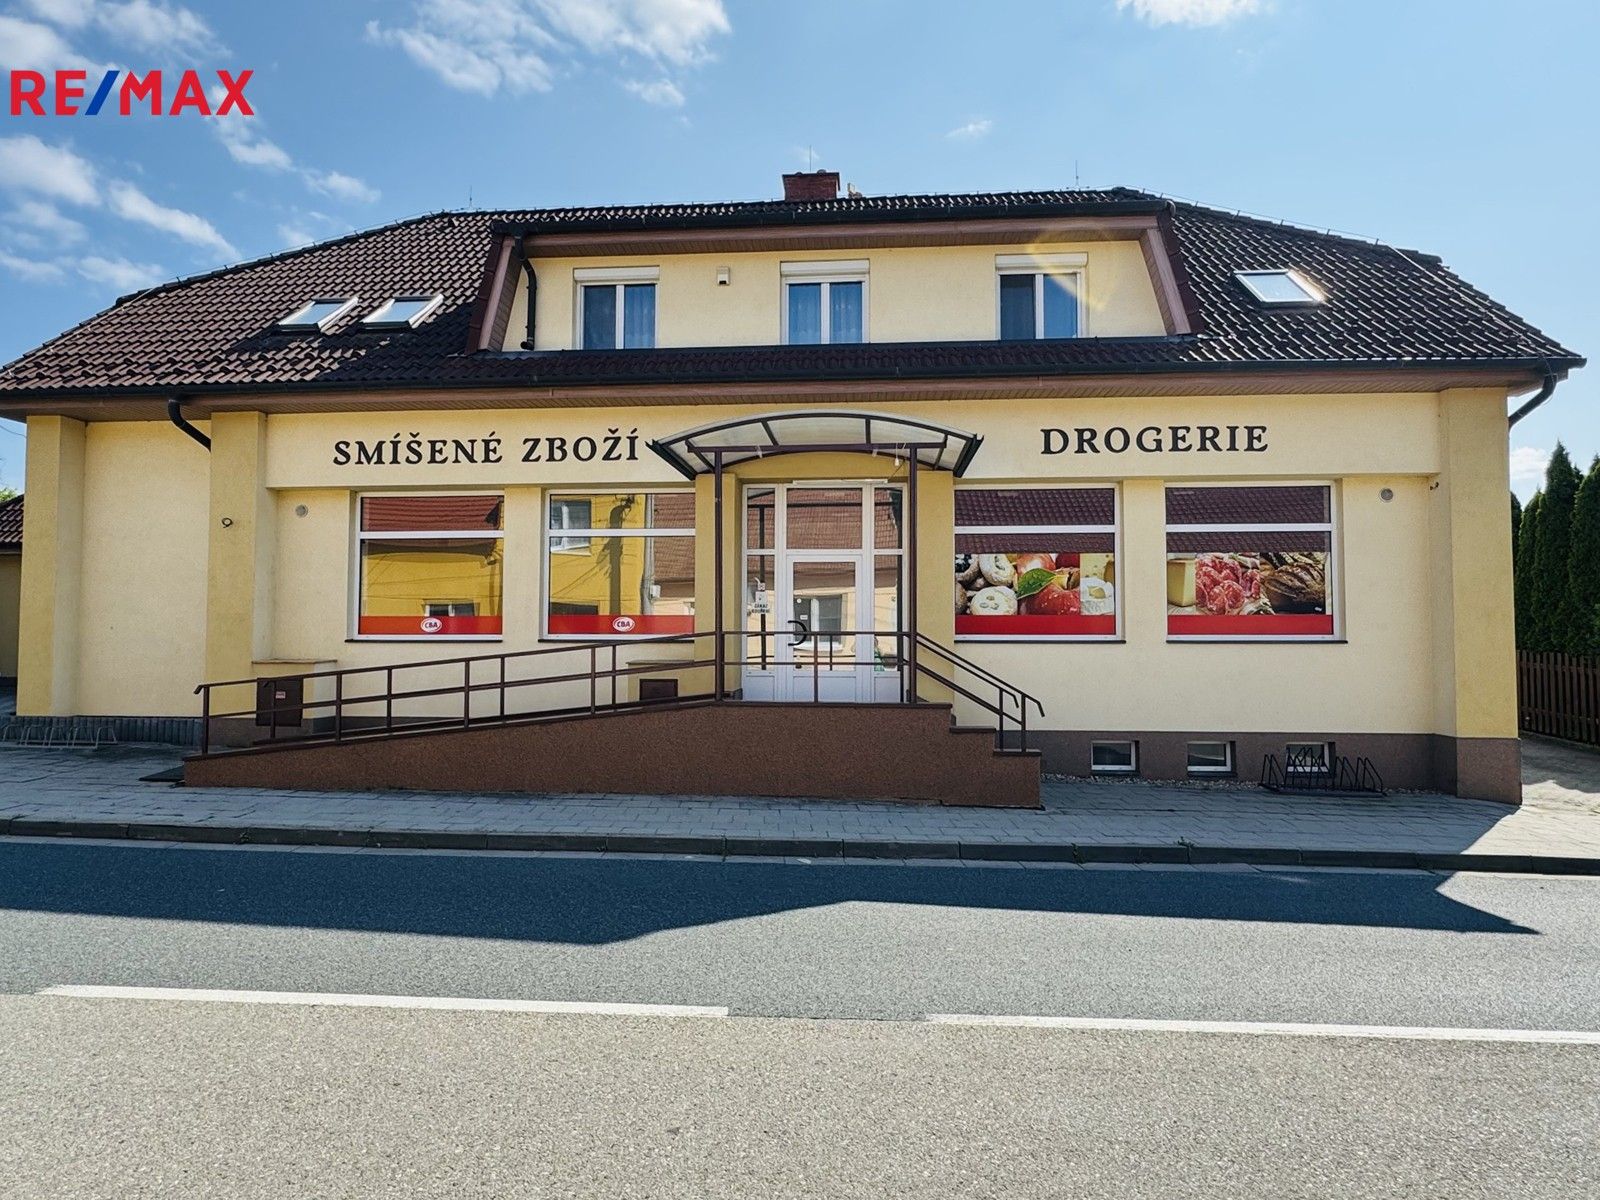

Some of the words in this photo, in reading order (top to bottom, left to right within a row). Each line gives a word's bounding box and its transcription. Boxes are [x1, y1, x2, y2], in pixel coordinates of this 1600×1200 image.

[333, 431, 503, 466] SMÍŠENÉ
[522, 428, 639, 462] ZBOŽÍ
[1039, 426, 1269, 454] DROGERIE
